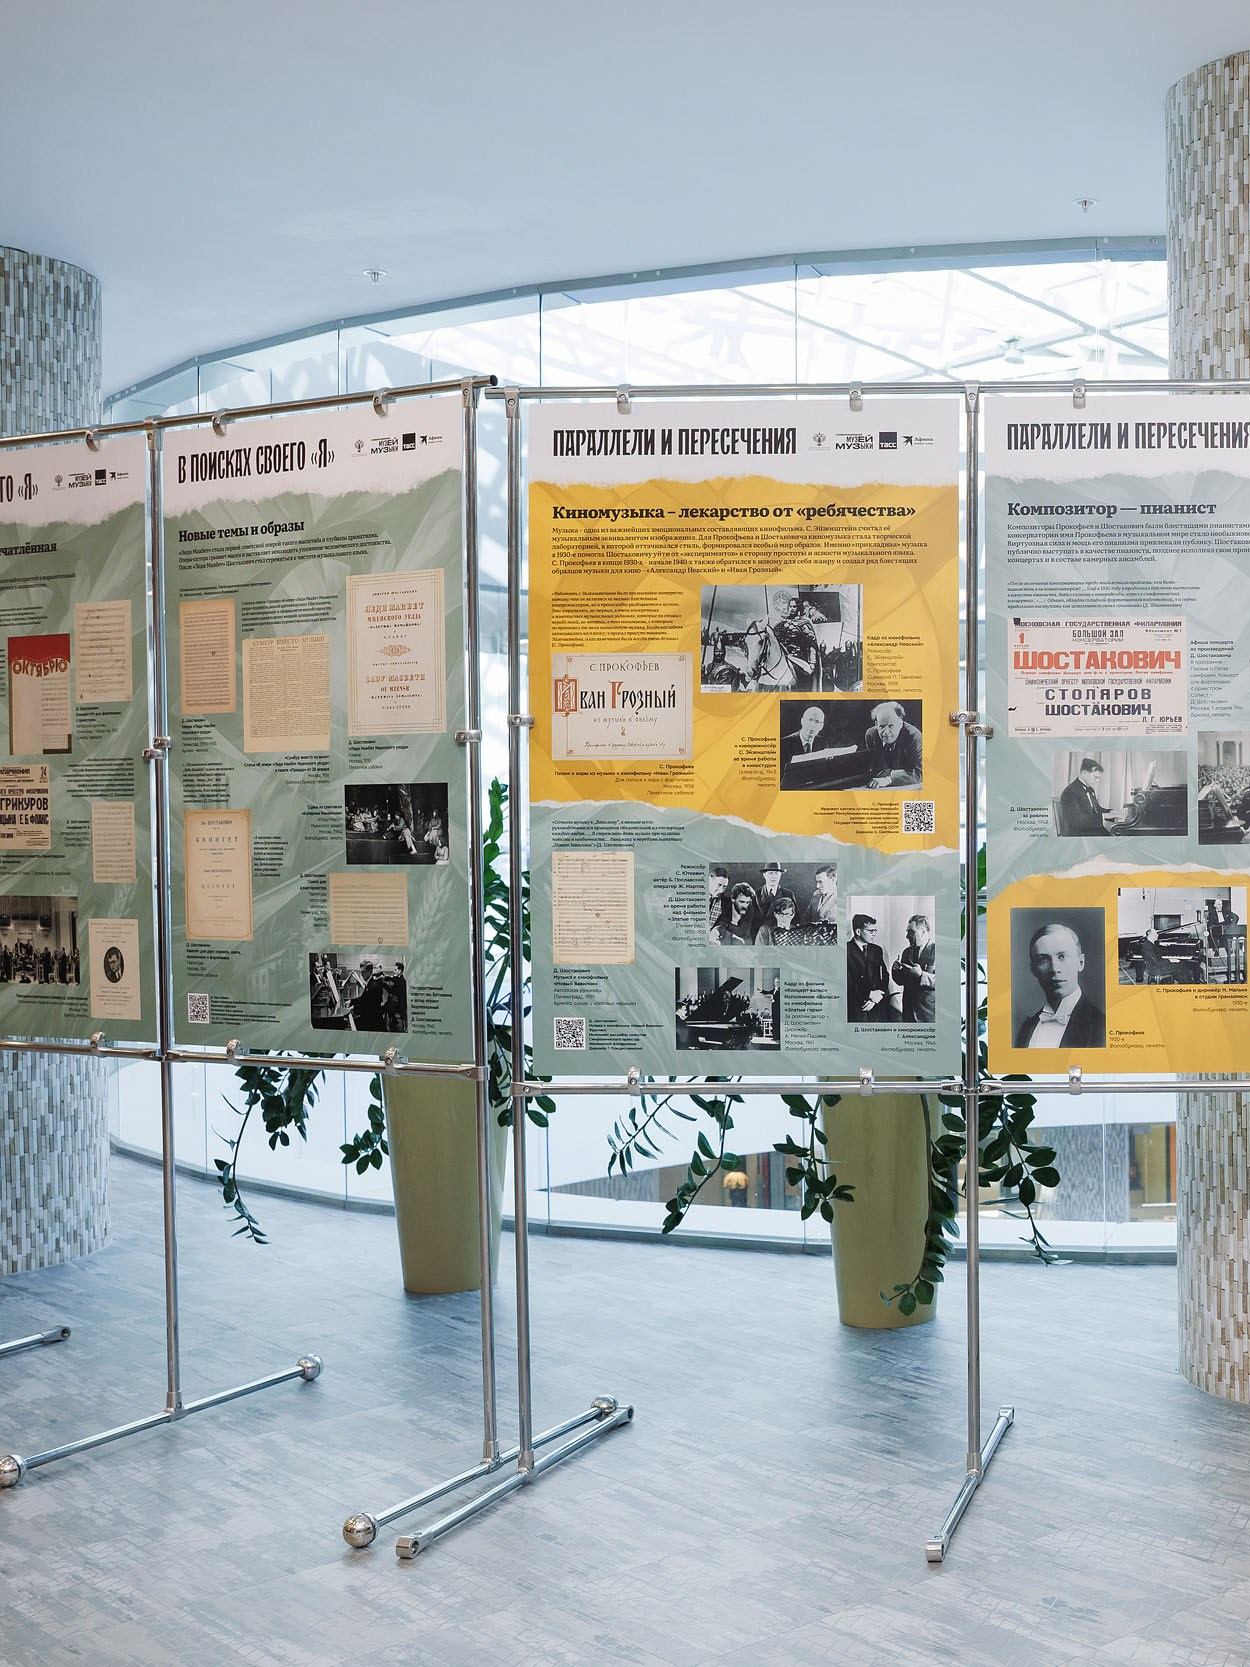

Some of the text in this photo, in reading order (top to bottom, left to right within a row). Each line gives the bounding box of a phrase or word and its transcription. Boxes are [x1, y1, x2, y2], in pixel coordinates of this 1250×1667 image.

[554, 428, 796, 456] ПАРАЛЛЕЛИ И ПЕРЕСЕЧЕНИЯ
[844, 434, 873, 442] МУЗЕЙ
[1008, 423, 1111, 450] ПАРАЛЛЕЛИ
[1118, 423, 1128, 449] И
[178, 439, 334, 483] В ПОИСКАХ СВОЕГО «Я»
[18, 473, 38, 500] «Я»
[553, 506, 665, 521] Киномузыка
[678, 508, 770, 520] лекарство
[773, 508, 793, 517] от
[796, 503, 916, 520] «ребячества»
[1008, 503, 1117, 520] Композитор
[1140, 504, 1216, 518] пианист
[179, 522, 304, 542] Новые темы и образы
[1018, 633, 1024, 643] 1
[1073, 629, 1123, 638] БОЛЬШОЙ ЗАЛ
[13, 658, 67, 677] ОКТЯБРЮ
[1014, 651, 1181, 670] ШОСТАКОВИЧ
[1045, 688, 1151, 700] СТОЛЯРОВ
[1046, 704, 1151, 716] ШОСТАКОВИЧ
[0, 798, 48, 811] ГРИКУРОВ
